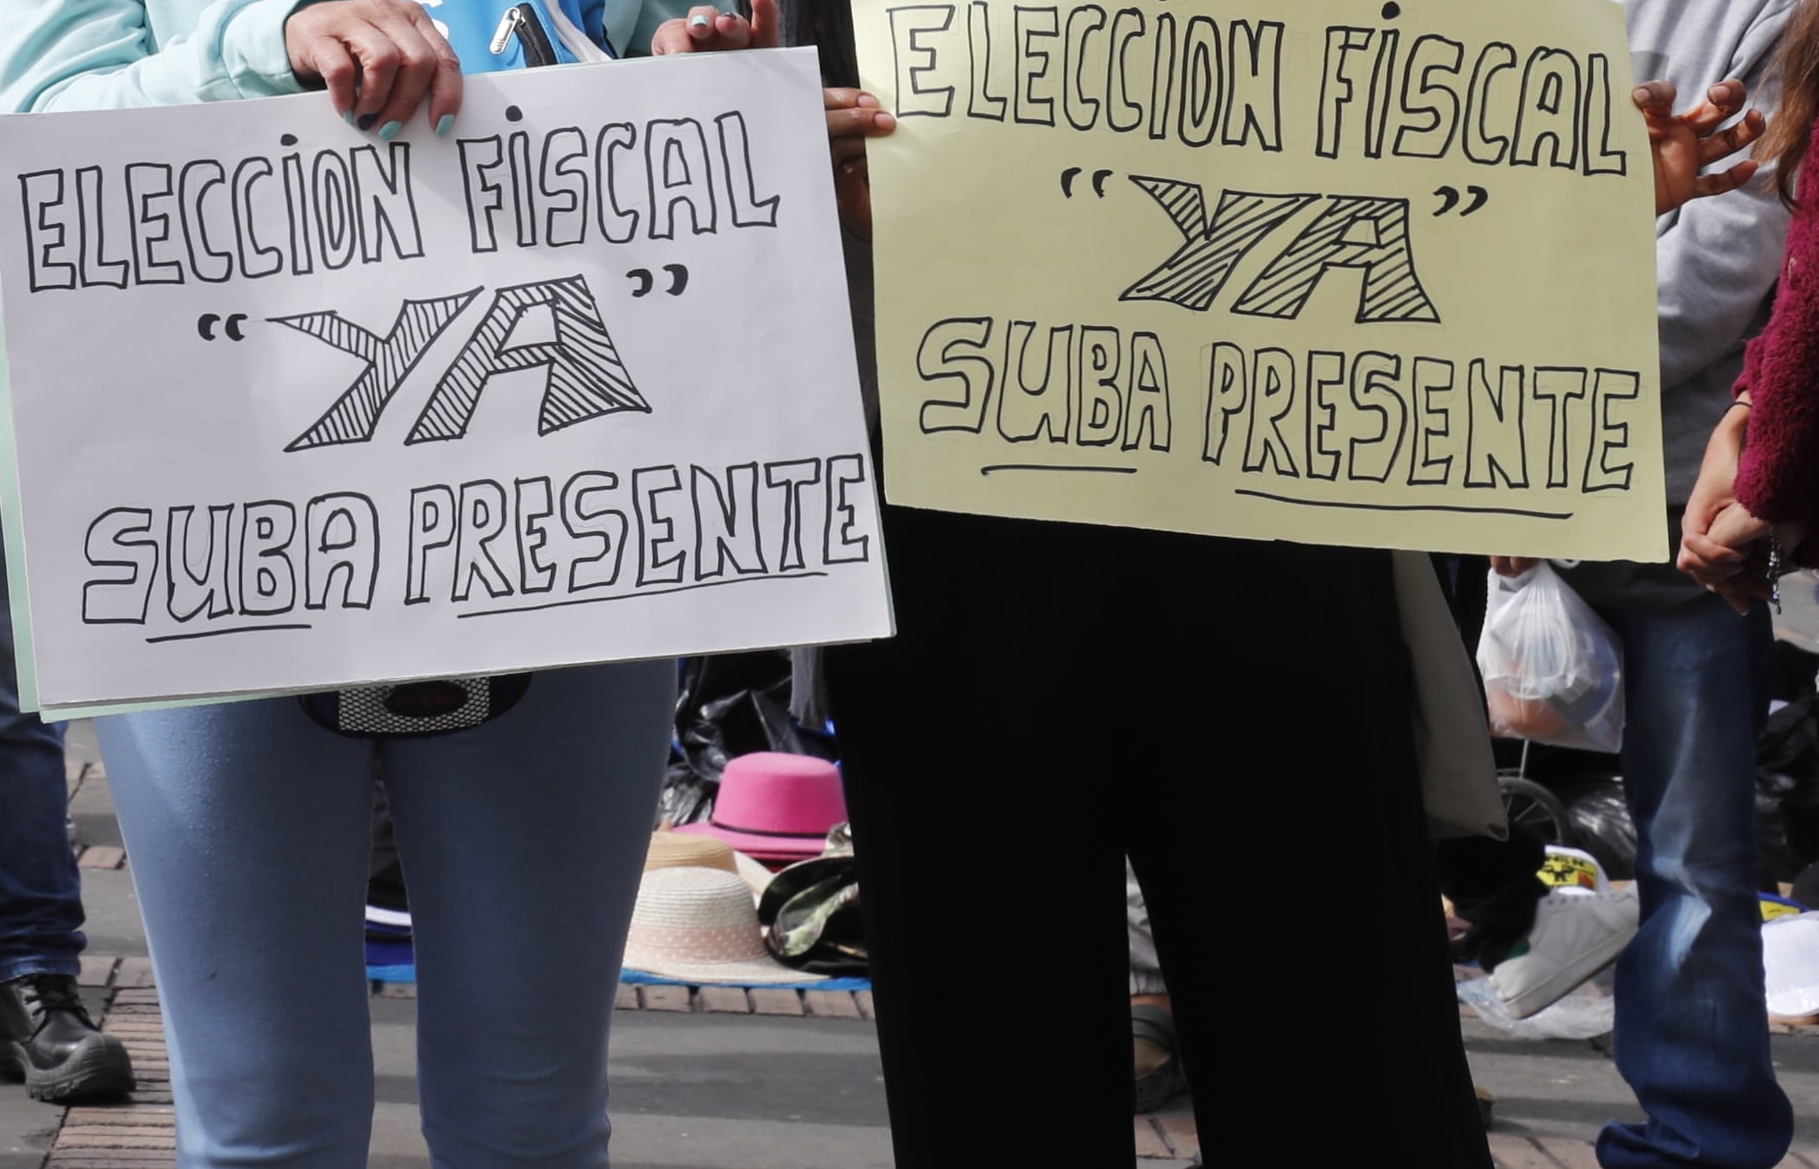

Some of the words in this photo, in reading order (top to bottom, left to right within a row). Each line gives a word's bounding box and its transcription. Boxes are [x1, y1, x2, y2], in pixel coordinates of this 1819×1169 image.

[915, 315, 1172, 453] SUBA
[1202, 341, 1641, 493] PRESENTE
[82, 490, 382, 624] SUBA
[404, 452, 871, 605] PRESENTE
